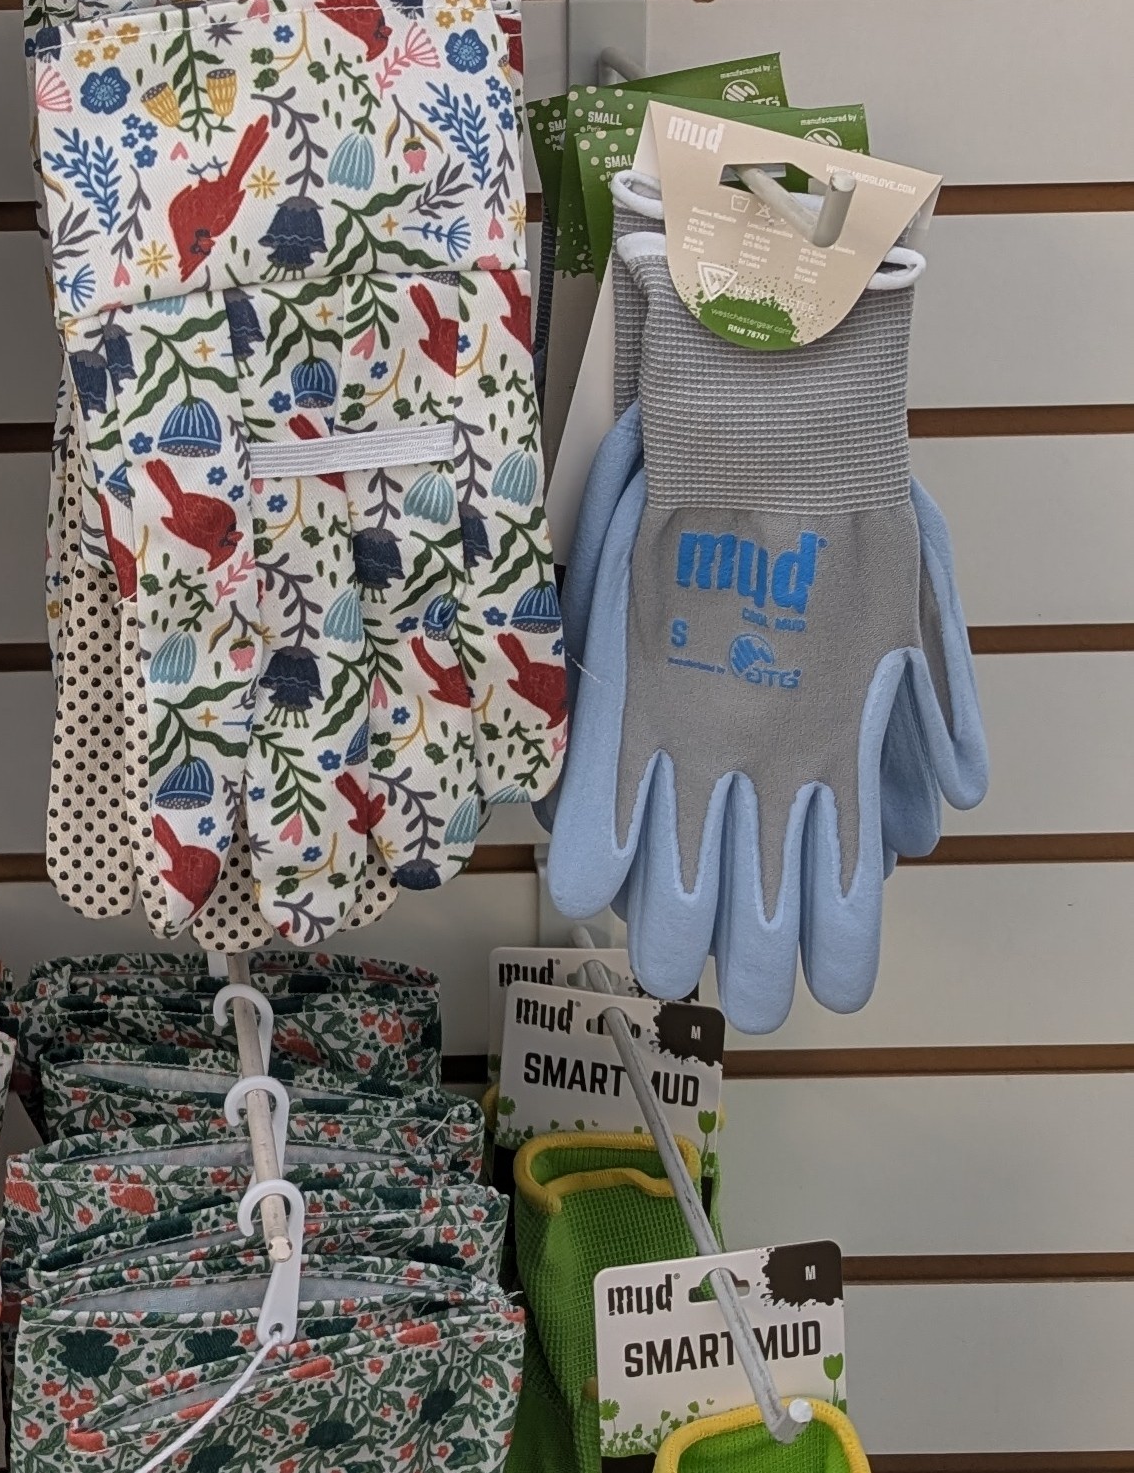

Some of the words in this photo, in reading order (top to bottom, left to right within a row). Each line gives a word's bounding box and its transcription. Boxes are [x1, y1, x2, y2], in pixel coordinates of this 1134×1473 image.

[548, 118, 567, 133] SMA
[587, 110, 623, 126] SMALL
[800, 114, 847, 126] manufactured
[848, 113, 857, 123] by
[666, 115, 726, 154] mud
[604, 153, 635, 169] SMAL
[746, 328, 771, 342] 78747
[675, 531, 818, 614] mud
[670, 618, 688, 648] S
[498, 958, 554, 987] mud
[515, 997, 575, 1035] mud
[691, 1025, 701, 1040] M
[523, 1052, 627, 1097] SMART
[804, 1264, 817, 1281] M
[607, 1273, 674, 1316] mud
[623, 1330, 735, 1378] SMART
[752, 1320, 821, 1363] MUD
